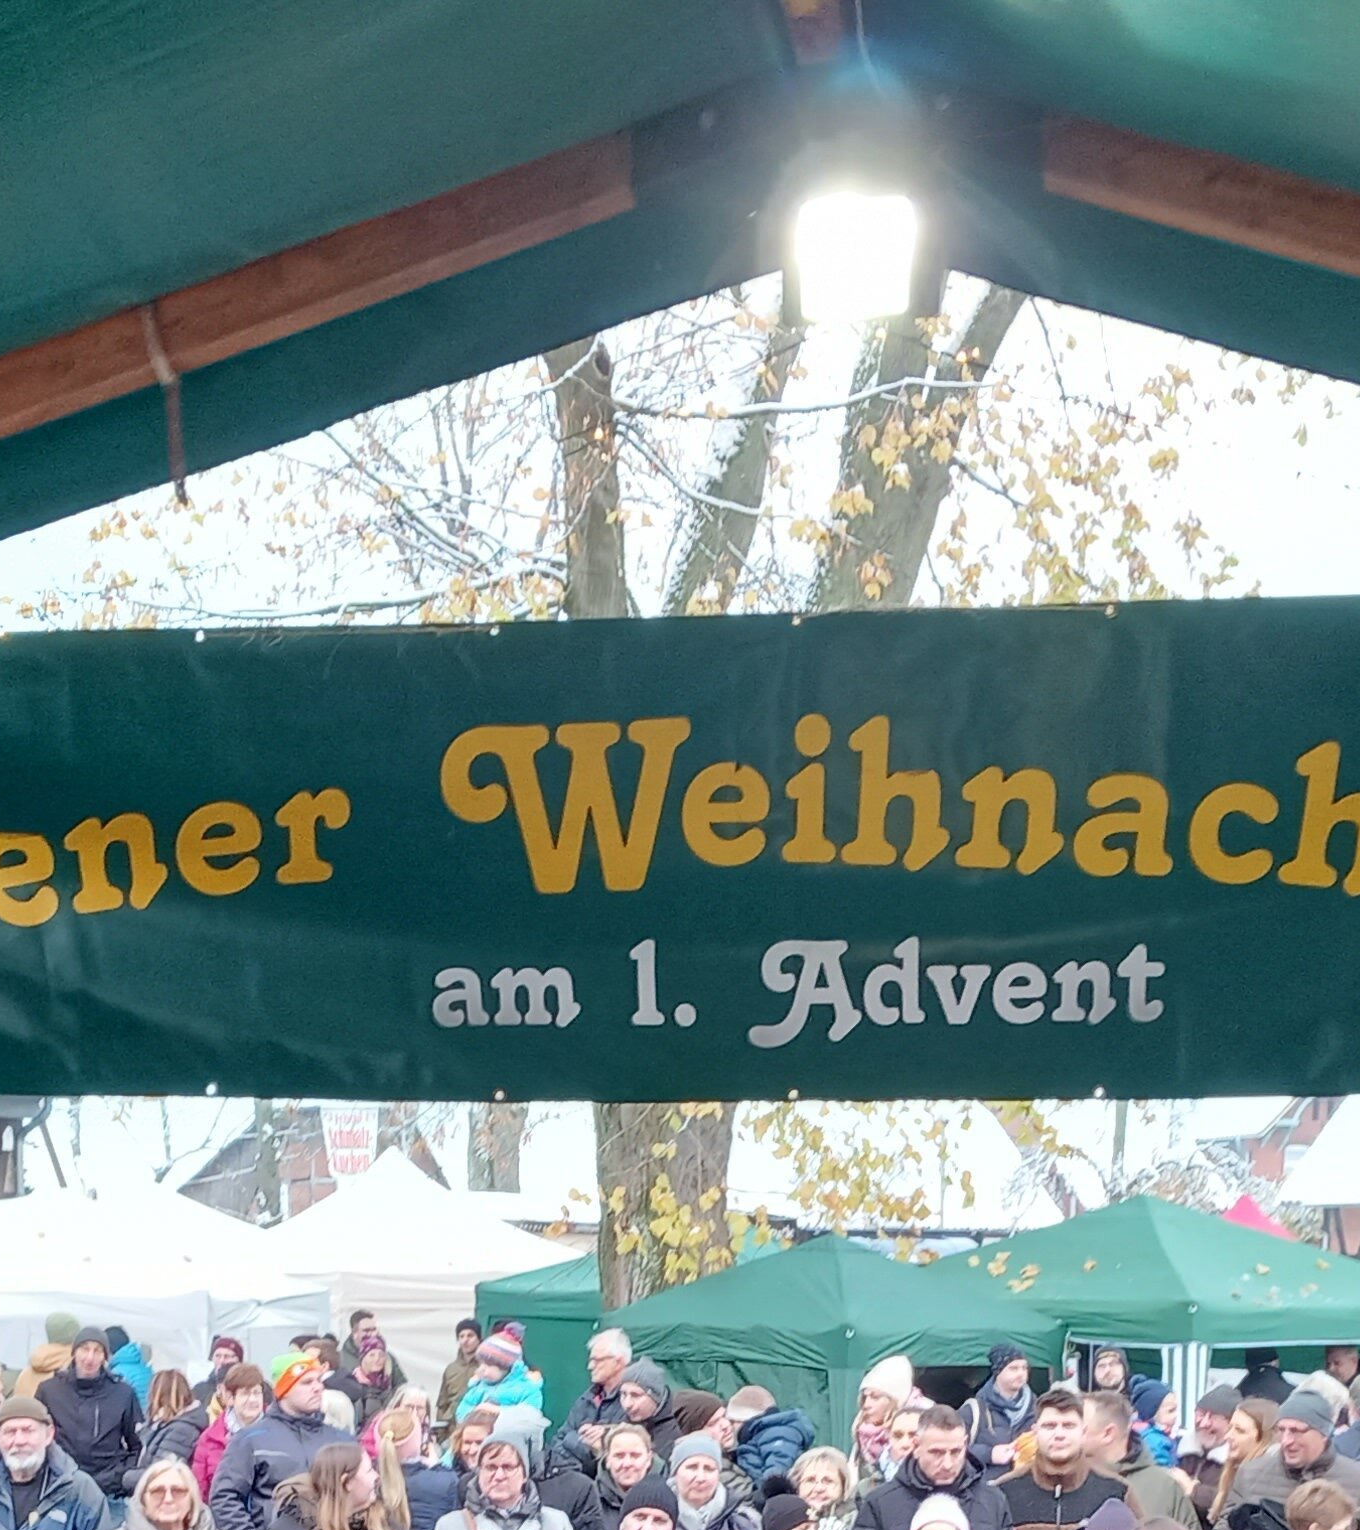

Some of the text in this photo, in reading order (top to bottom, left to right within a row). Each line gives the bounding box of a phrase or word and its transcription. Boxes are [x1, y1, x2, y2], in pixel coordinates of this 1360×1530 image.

[431, 936, 1167, 1049] am 1. Advent
